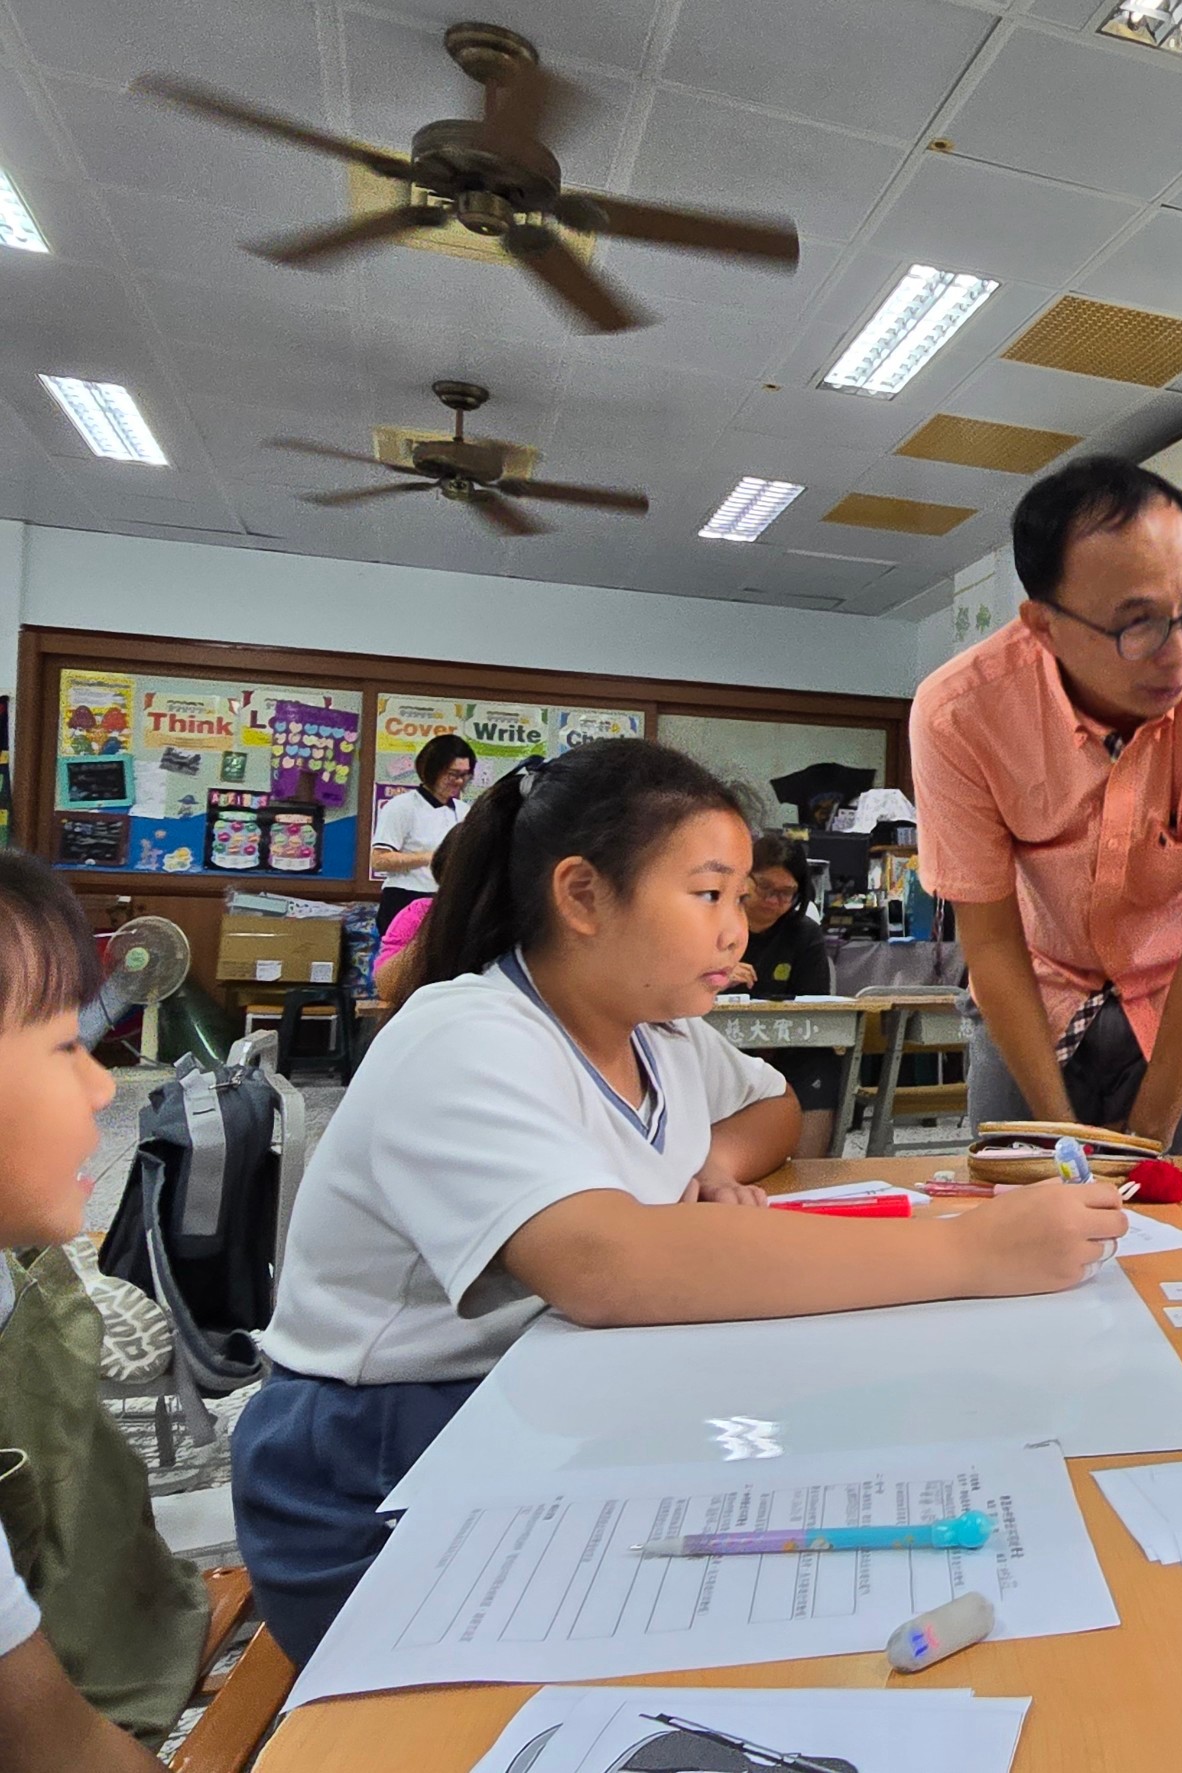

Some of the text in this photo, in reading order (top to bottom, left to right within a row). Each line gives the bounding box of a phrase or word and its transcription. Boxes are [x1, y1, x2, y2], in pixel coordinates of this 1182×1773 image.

[147, 711, 234, 736] Think
[385, 717, 458, 737] Cover
[473, 721, 542, 744] Write
